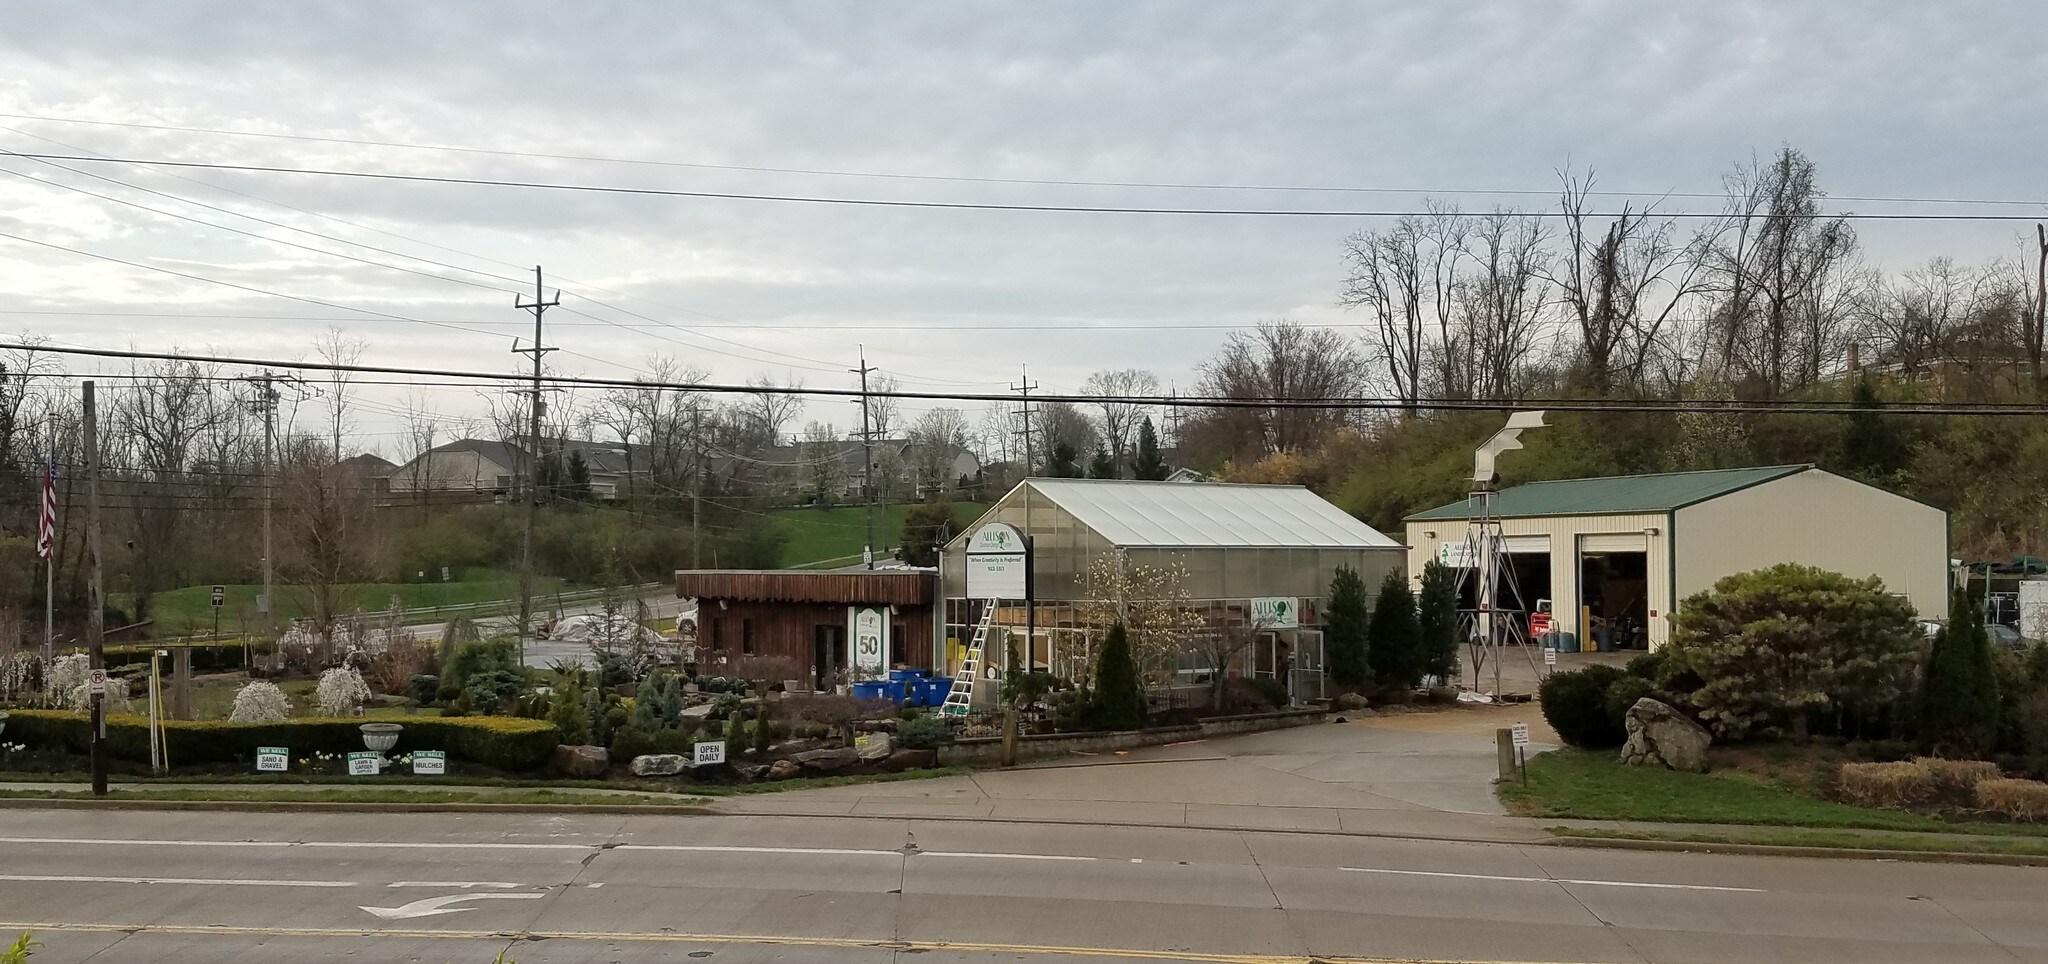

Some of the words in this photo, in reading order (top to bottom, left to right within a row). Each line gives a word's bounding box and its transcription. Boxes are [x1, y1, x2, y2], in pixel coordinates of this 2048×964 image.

[982, 530, 1010, 542] ALLISON
[1253, 601, 1293, 614] ALLISON
[860, 636, 878, 655] 50
[700, 745, 719, 753] OPEN
